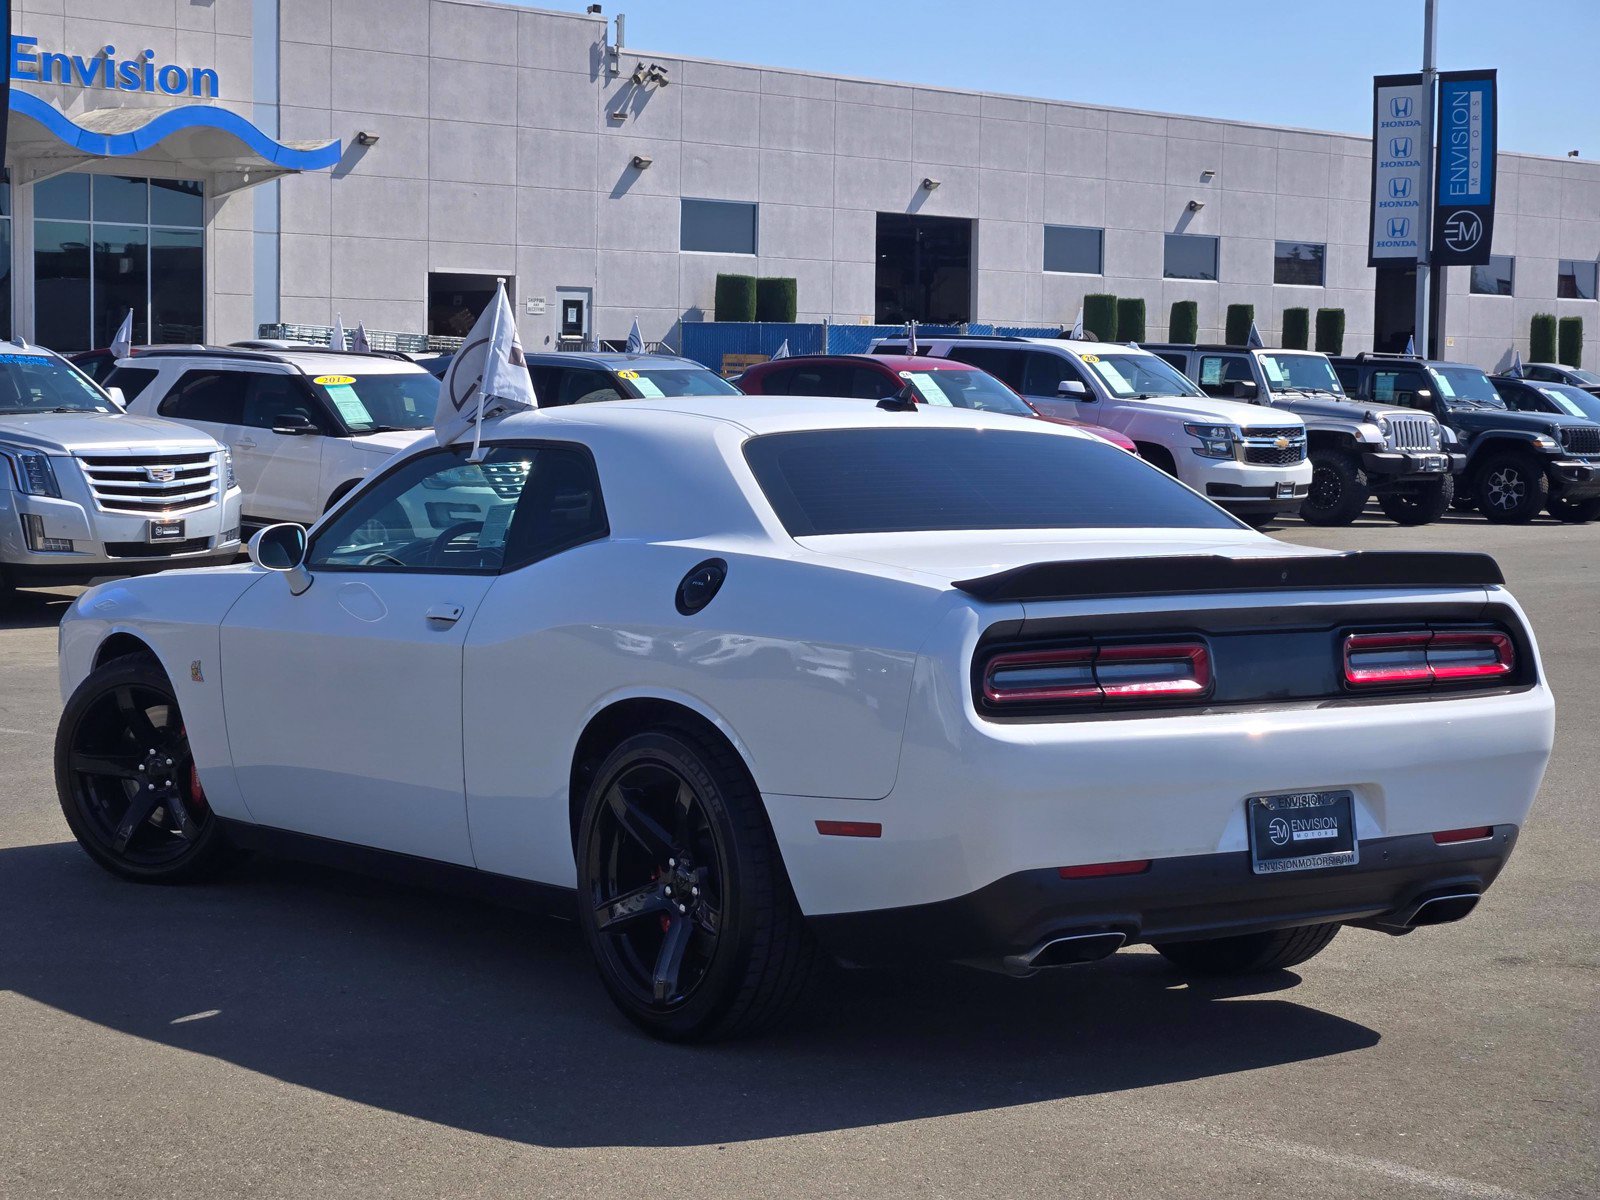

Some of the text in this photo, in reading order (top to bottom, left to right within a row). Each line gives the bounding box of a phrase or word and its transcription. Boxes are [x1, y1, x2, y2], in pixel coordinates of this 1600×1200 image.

[10, 35, 219, 98] Envision
[1380, 120, 1421, 129] HONDA
[1450, 91, 1469, 196] ENVISION
[1472, 100, 1480, 186] MOTORS
[1380, 160, 1421, 168] HONDA
[1379, 200, 1419, 208] HONDA
[1376, 240, 1417, 248] HONDA
[1279, 794, 1326, 809] ENVISION
[1291, 817, 1338, 832] ENVISION
[1296, 830, 1334, 839] MOTORS
